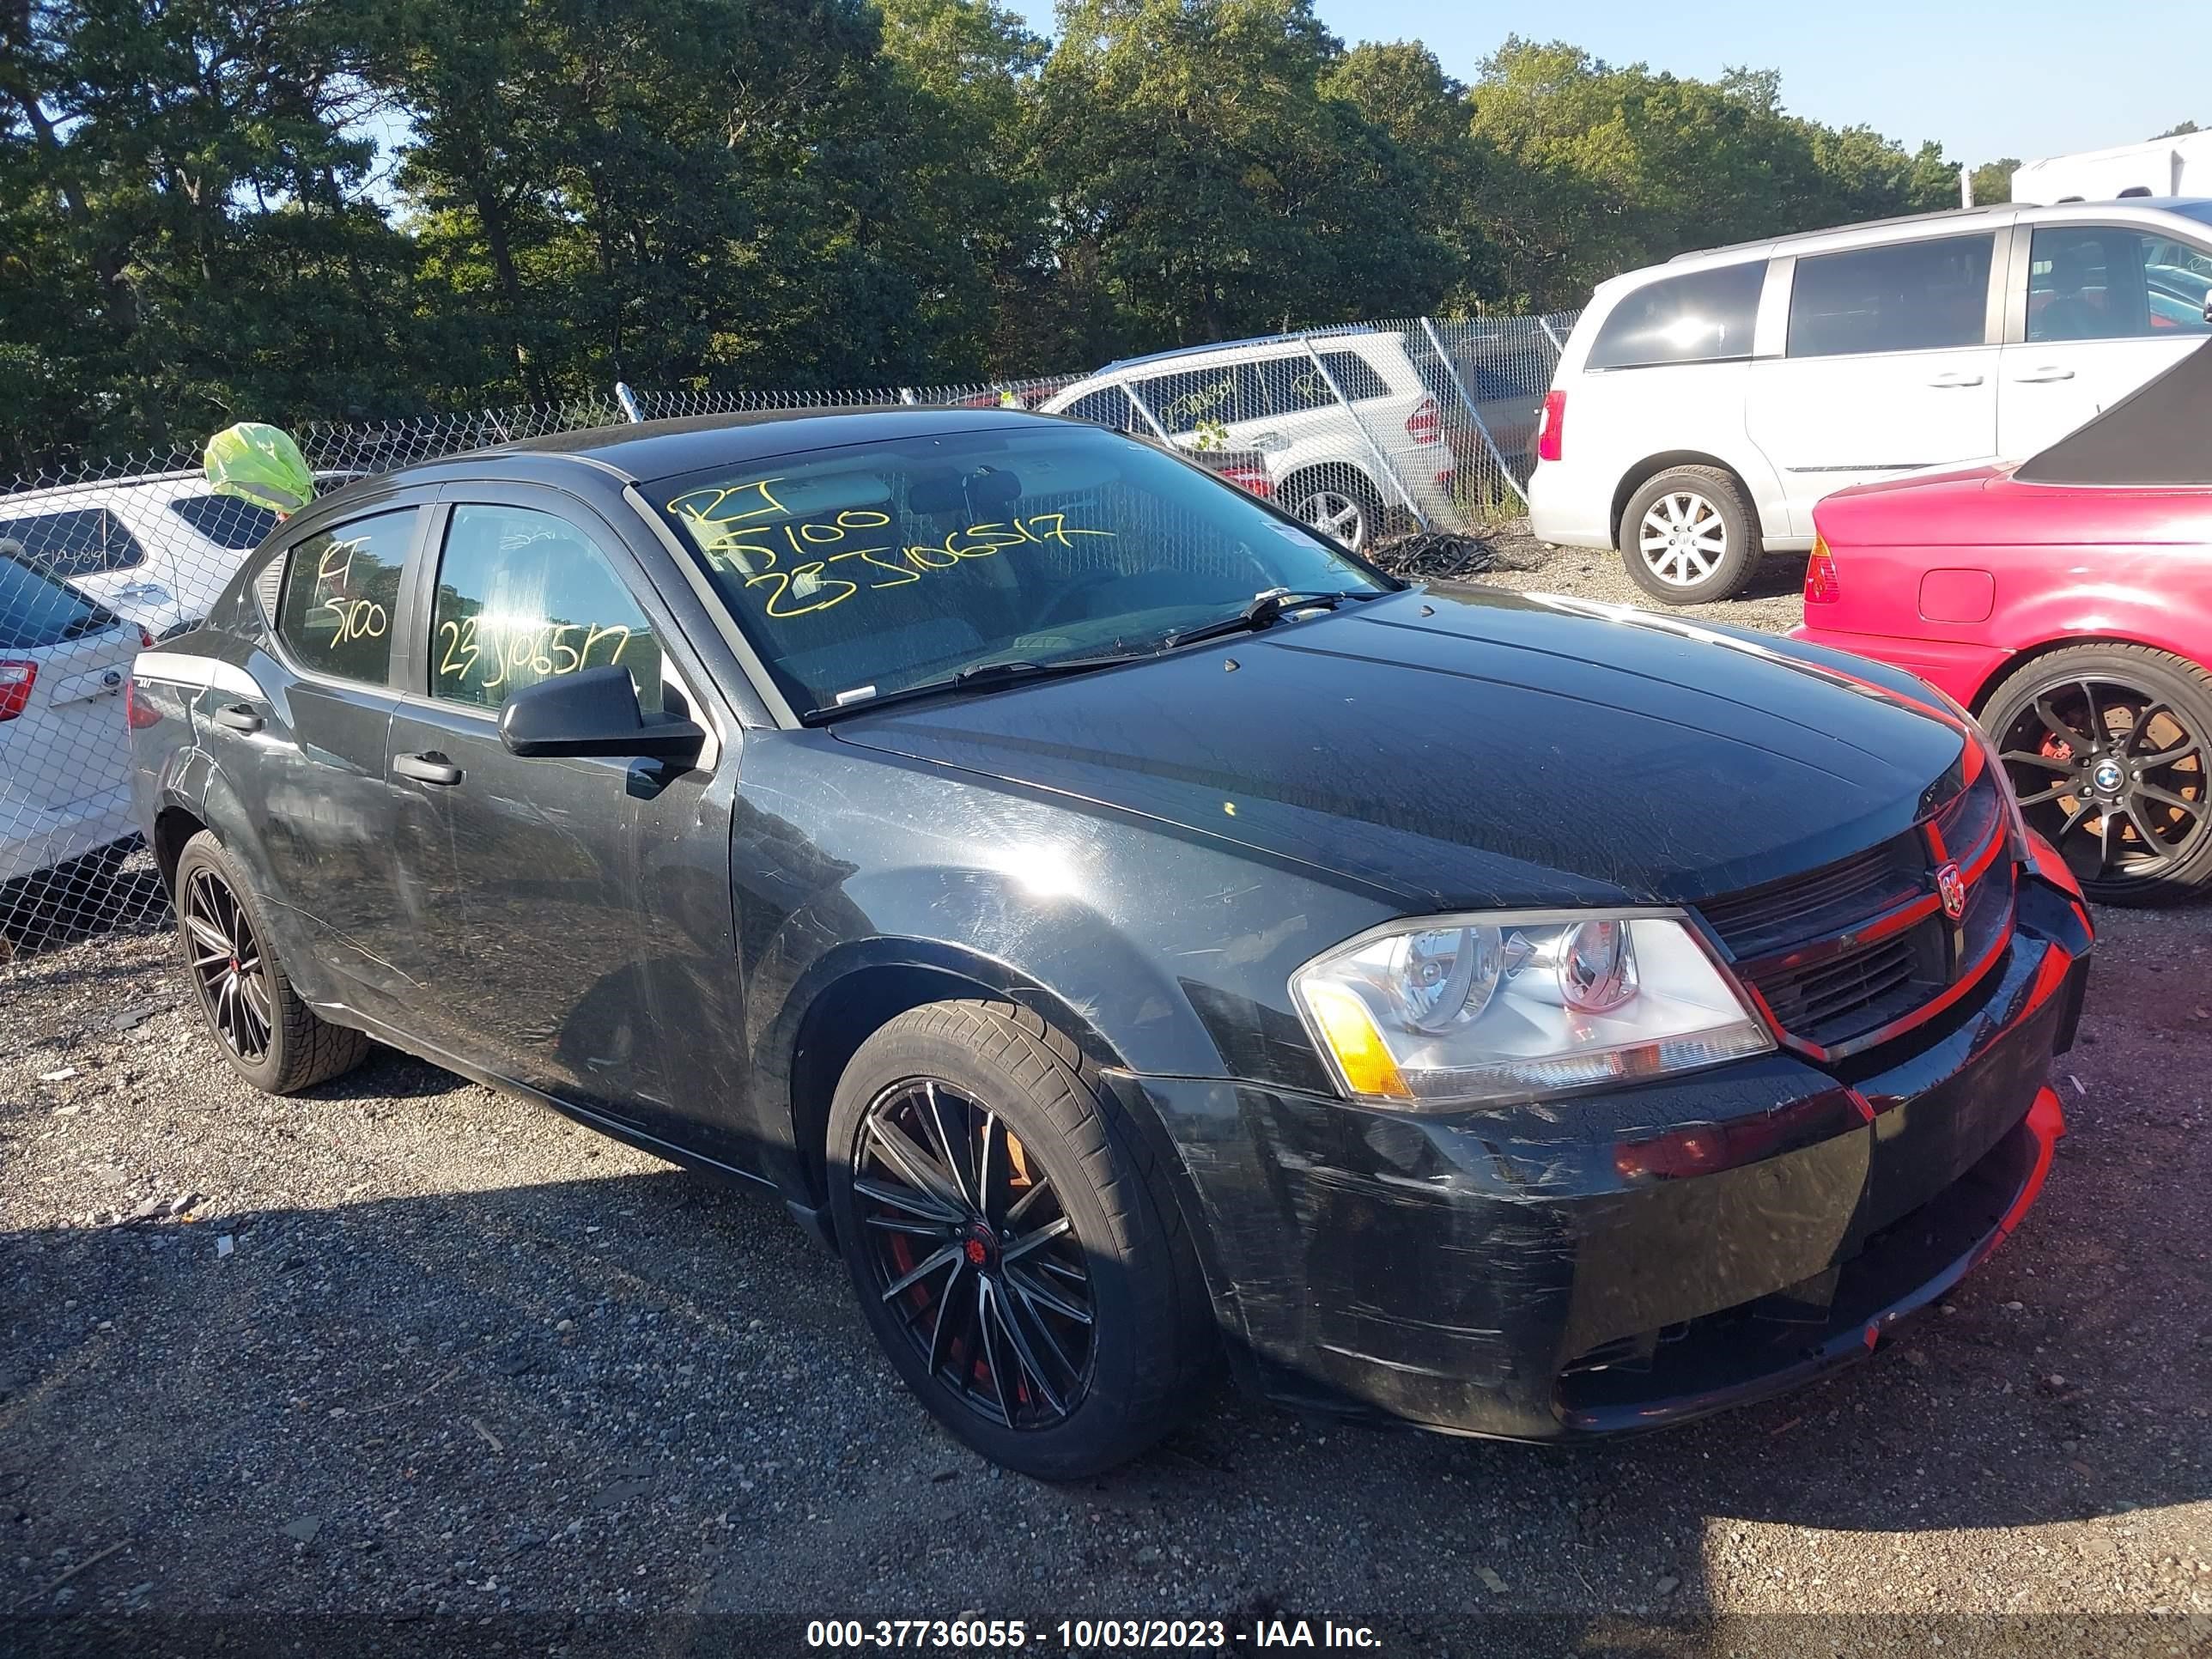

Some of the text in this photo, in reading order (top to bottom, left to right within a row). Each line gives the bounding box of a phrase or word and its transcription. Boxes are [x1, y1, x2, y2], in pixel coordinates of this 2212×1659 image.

[313, 536, 371, 598] RT
[707, 511, 890, 569] 5100
[325, 597, 386, 650] 5100
